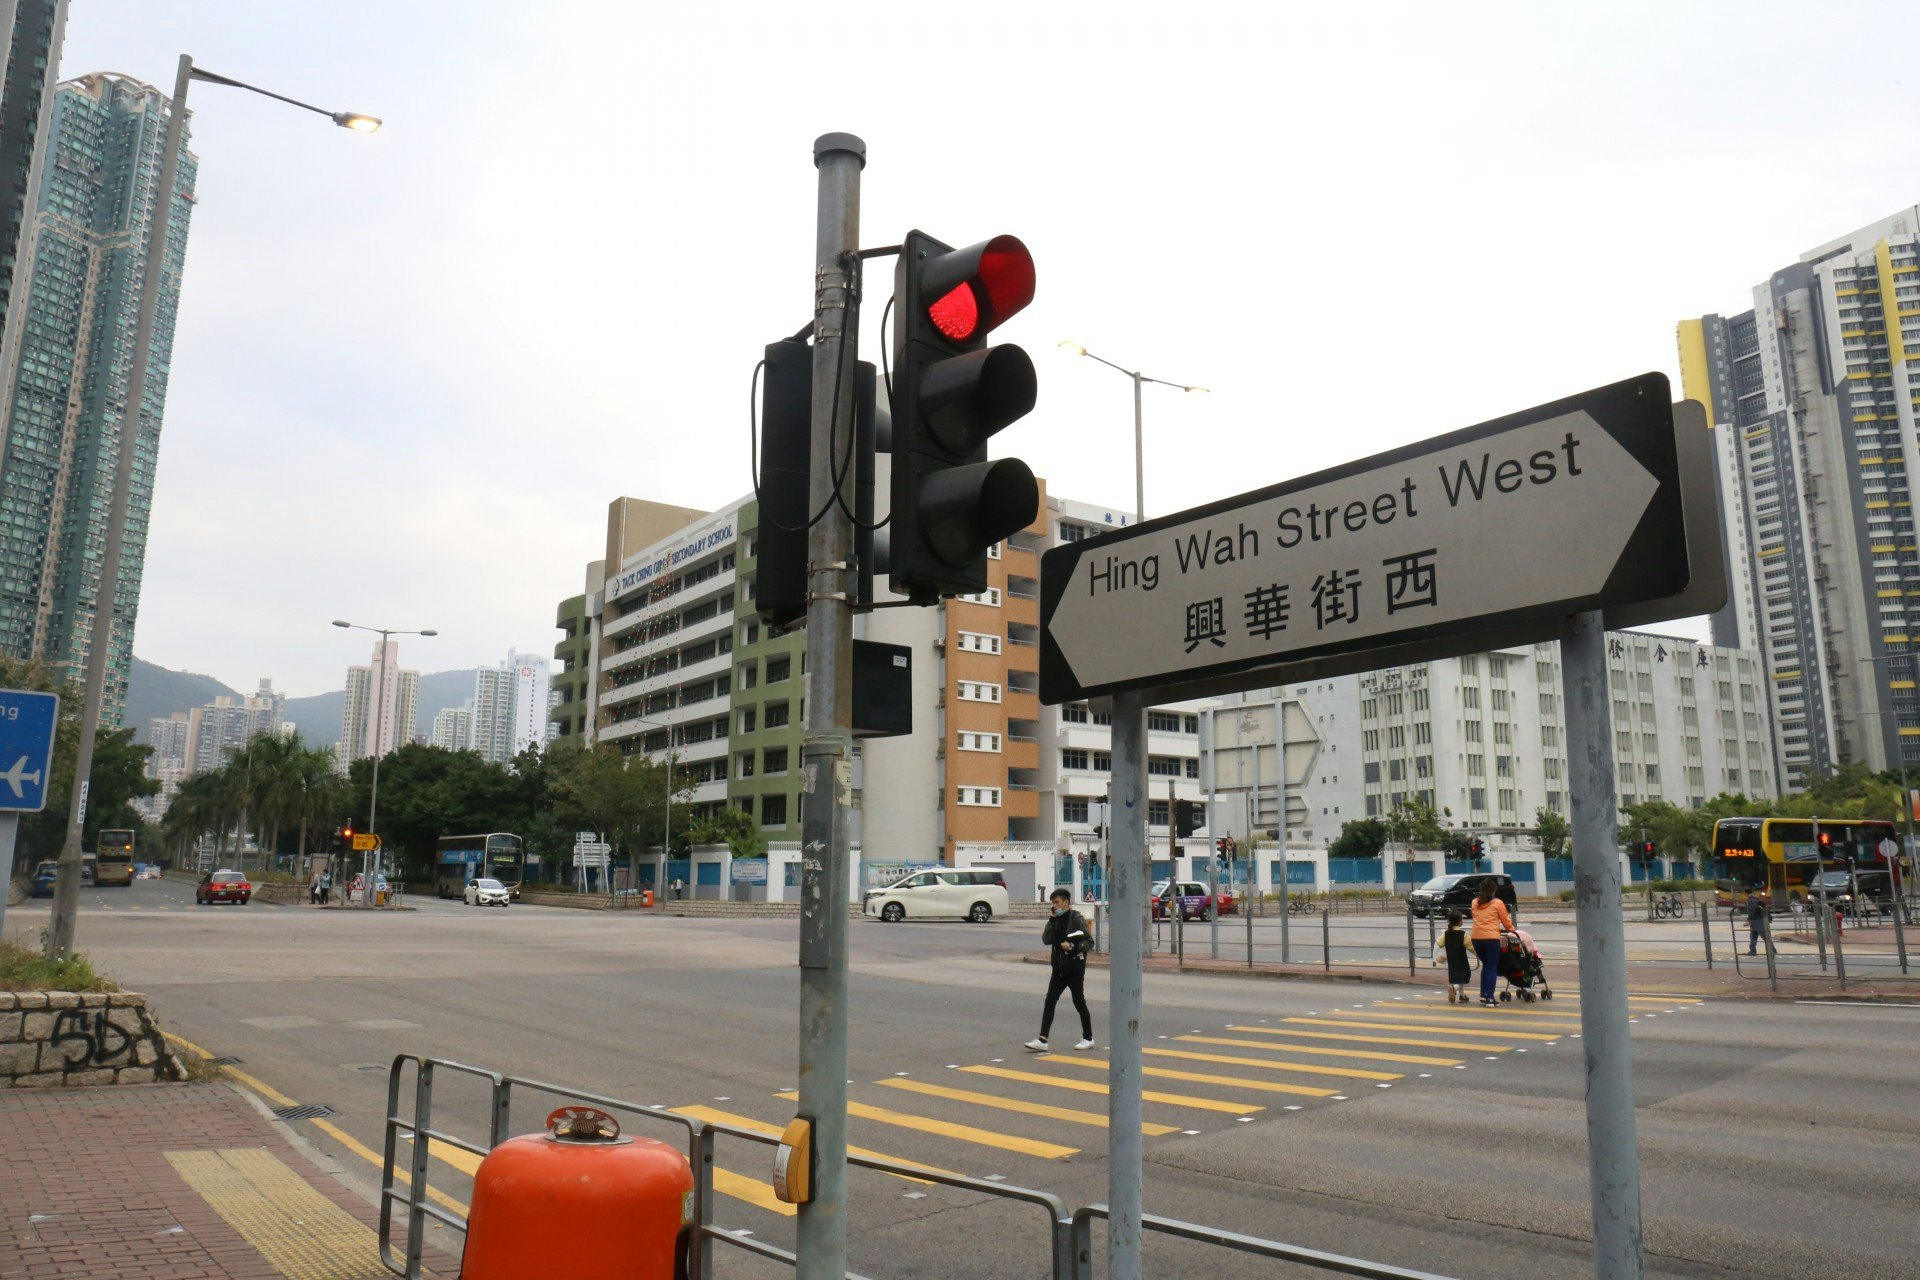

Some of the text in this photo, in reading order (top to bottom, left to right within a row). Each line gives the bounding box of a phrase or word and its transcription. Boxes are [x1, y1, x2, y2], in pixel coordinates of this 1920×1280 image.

[622, 573, 636, 590] TACK
[635, 564, 652, 582] CHING
[671, 538, 707, 565] SECONDARY
[707, 524, 733, 548] SCHOOL
[1090, 432, 1582, 596] Hing Wah Street West
[1183, 548, 1438, 654] 興華街西
[1743, 849, 1754, 857] A21
